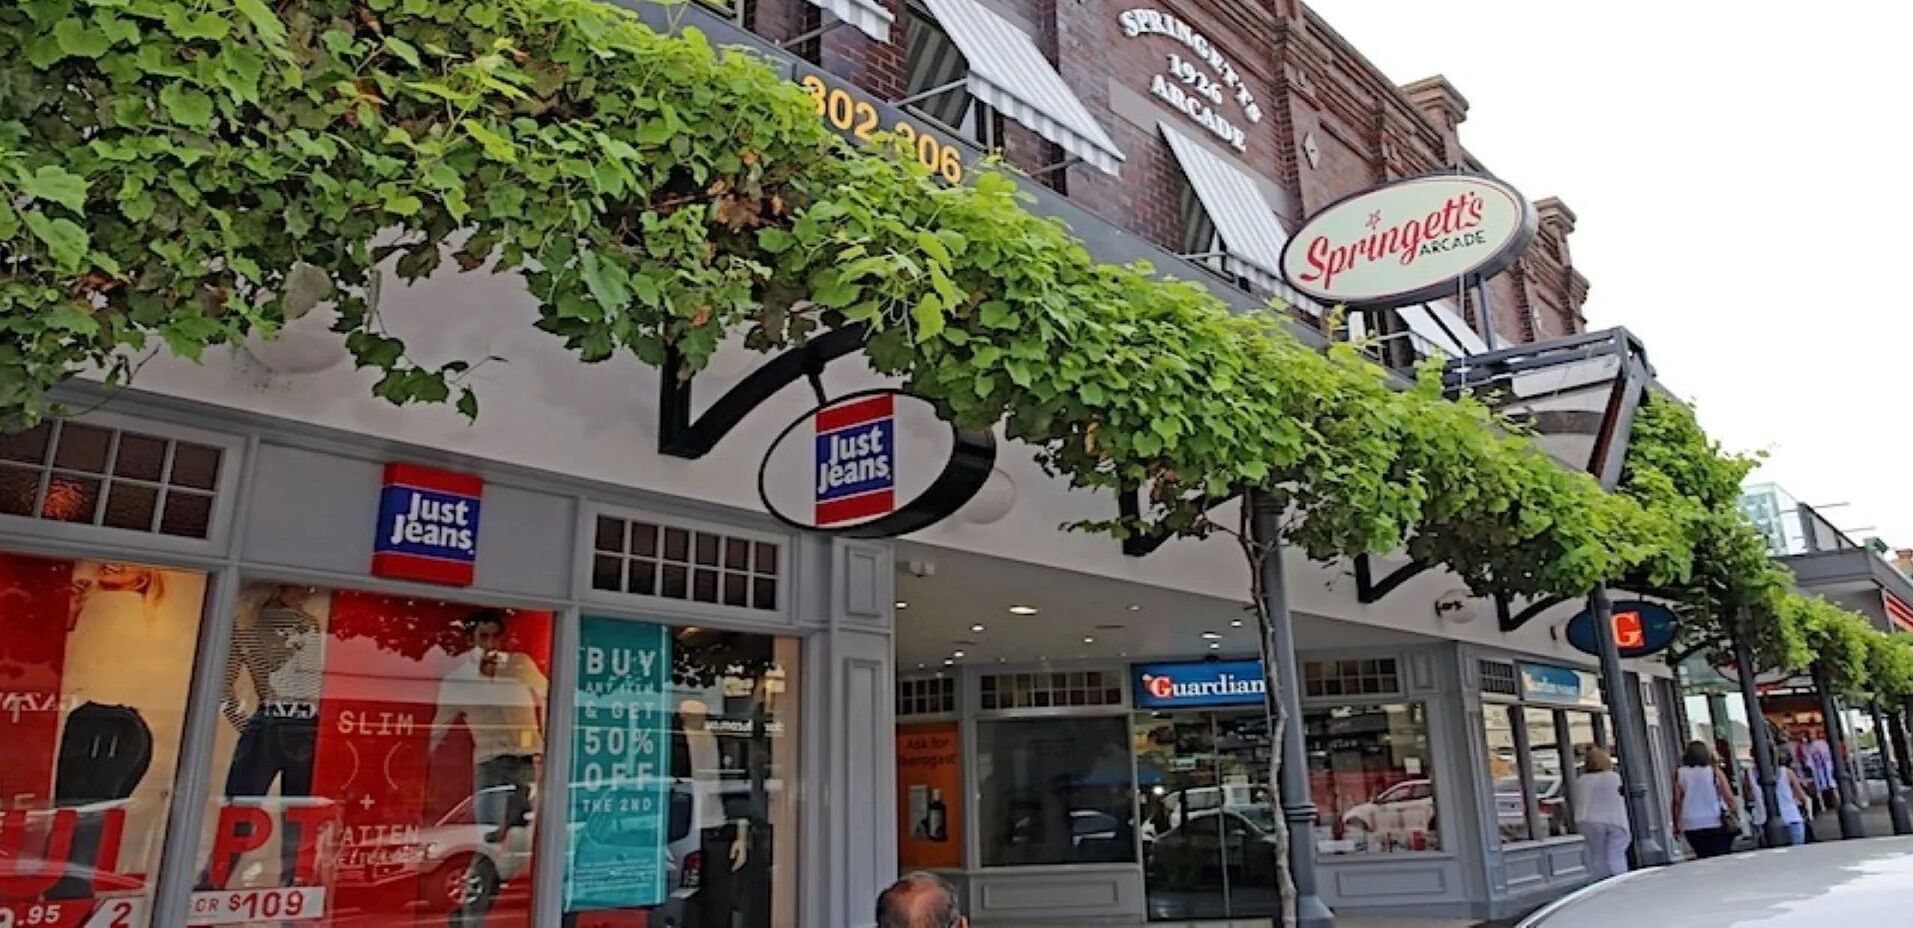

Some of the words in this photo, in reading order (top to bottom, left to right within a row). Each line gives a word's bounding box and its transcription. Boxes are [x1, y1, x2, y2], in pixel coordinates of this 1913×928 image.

[1167, 53, 1223, 105] 1926
[802, 74, 962, 185] 302306
[1151, 74, 1247, 153] ARCADE
[1300, 191, 1485, 290] Springett's
[1418, 230, 1487, 257] ARCADE
[828, 425, 884, 467] Just
[817, 455, 890, 495] Jeans
[407, 491, 470, 527] Just
[390, 514, 473, 551] Jeans
[1610, 610, 1645, 649] G
[585, 646, 656, 677] BUY
[1149, 674, 1266, 699] Guardian
[337, 710, 415, 736] SLIM
[584, 701, 599, 719] &
[611, 702, 655, 720] GET
[584, 726, 654, 756] 50%
[584, 763, 655, 792] OFF
[581, 800, 612, 813] THE
[619, 798, 652, 812] 2ND
[110, 902, 132, 928] 2
[189, 898, 220, 913] OR
[228, 889, 304, 918] $109
